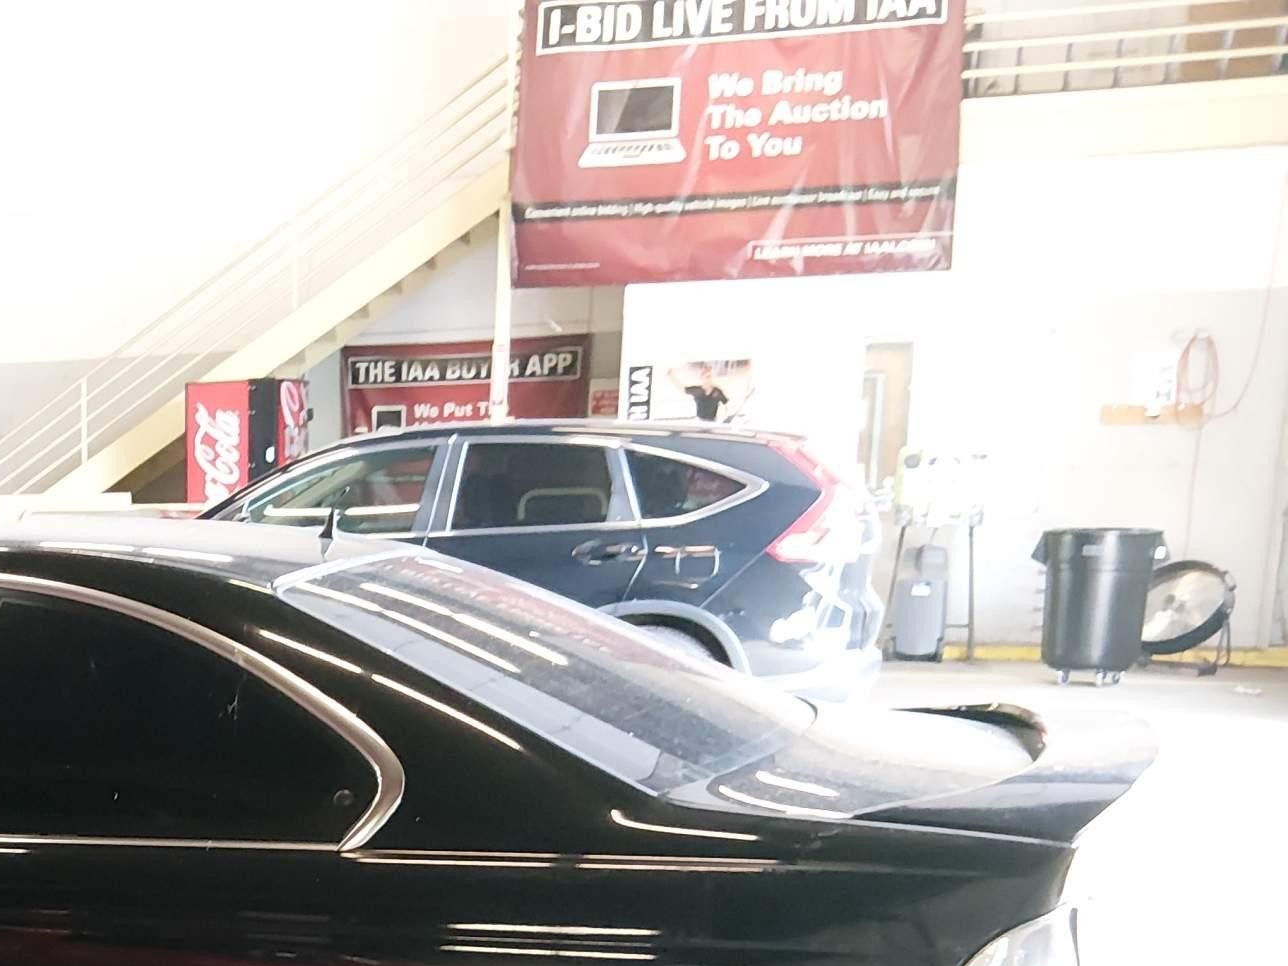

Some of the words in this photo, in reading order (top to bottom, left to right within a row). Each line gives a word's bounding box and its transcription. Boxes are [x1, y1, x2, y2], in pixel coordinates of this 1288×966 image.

[548, 4, 642, 45] I-BID
[652, 0, 733, 38] LIVE
[743, 0, 855, 31] FROM
[708, 72, 754, 99] We
[762, 68, 843, 96] Bring
[707, 103, 762, 129] The
[768, 96, 888, 125] Auction
[704, 135, 740, 160] To
[746, 132, 803, 157] You
[355, 361, 396, 383] THE
[401, 359, 440, 382] IAA
[445, 356, 520, 379] BUYR
[525, 353, 573, 376] APP
[414, 403, 439, 418] We
[443, 401, 473, 418] Put
